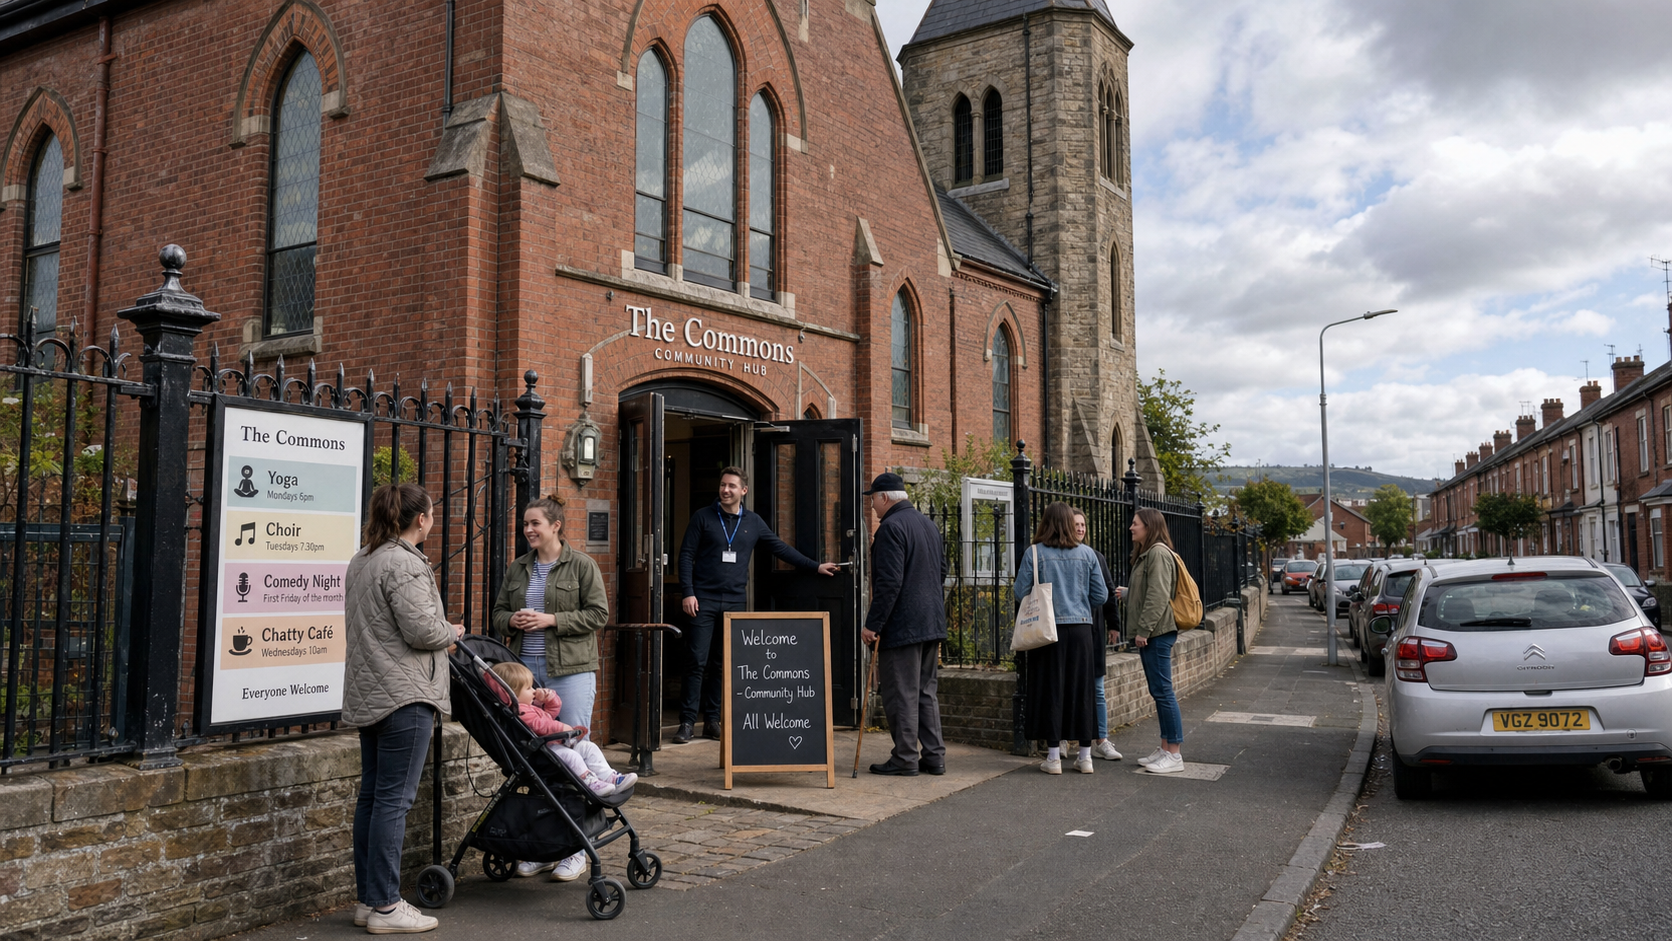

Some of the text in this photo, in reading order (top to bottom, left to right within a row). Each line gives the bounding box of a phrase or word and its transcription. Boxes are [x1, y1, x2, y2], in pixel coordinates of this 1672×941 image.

[625, 304, 795, 364] The Commons
[655, 348, 767, 376] COMMUNITY HUB
[240, 425, 346, 450] The Commons
[268, 470, 298, 489] Yoga
[267, 490, 314, 503] Mondays 6pm
[266, 522, 301, 537] Choir
[266, 541, 299, 553] Tuesdays
[264, 574, 341, 591] Comedy Night
[263, 593, 280, 603] First
[281, 594, 301, 604] Friday
[302, 593, 311, 602] of
[311, 593, 321, 602] the
[262, 625, 334, 644] Chatty Café
[741, 629, 798, 646] Welcome
[261, 645, 328, 658] Wednesdays 10am
[765, 648, 777, 660] to
[737, 664, 810, 680] The Commons
[242, 683, 330, 700] Everyone Welcome
[797, 685, 816, 698] Hub
[742, 712, 812, 730] All Welcome
[1500, 712, 1583, 729] VGZ 9072
